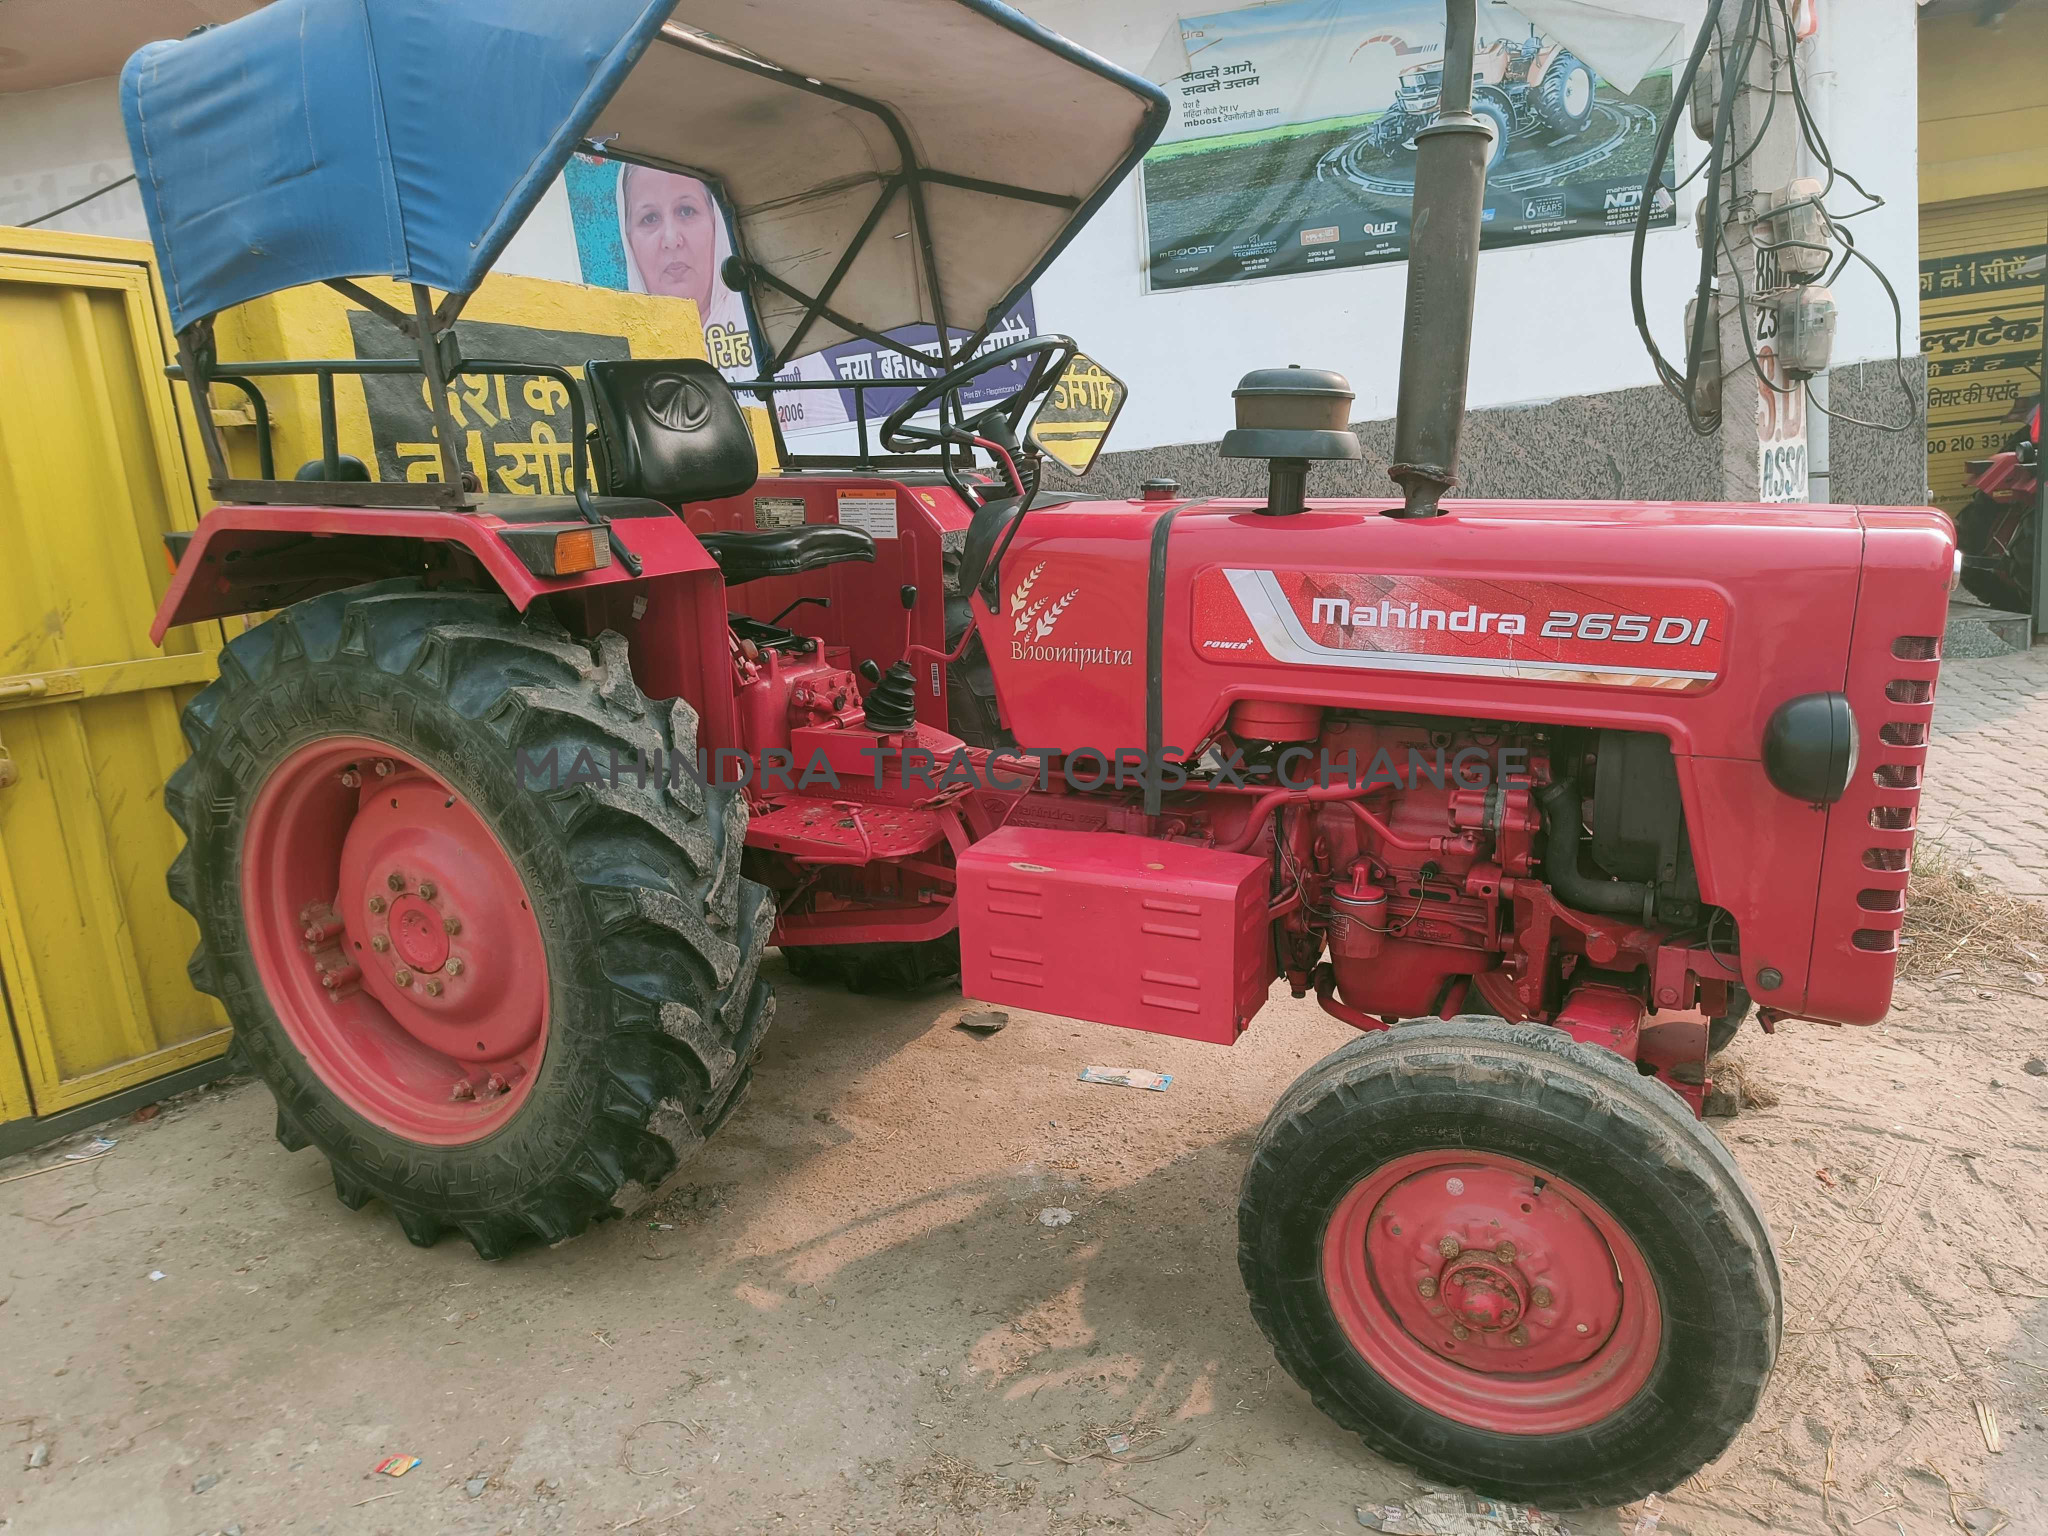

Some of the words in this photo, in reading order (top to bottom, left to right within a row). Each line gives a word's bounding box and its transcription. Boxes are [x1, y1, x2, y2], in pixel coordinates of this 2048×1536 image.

[1223, 60, 1256, 76] आगे,
[1181, 80, 1221, 96] सबसे
[1223, 75, 1260, 90] उत्तम
[1184, 115, 1222, 128] mboost
[1606, 184, 1643, 194] mahindra
[1536, 202, 1563, 214] YEARS
[1233, 247, 1278, 258] TECHNOLOGY
[1967, 261, 1976, 287] 1
[706, 321, 753, 370] सिंह
[963, 389, 974, 399] Print
[1951, 435, 1974, 452] 210
[1010, 639, 1133, 671] Bhoomiputra
